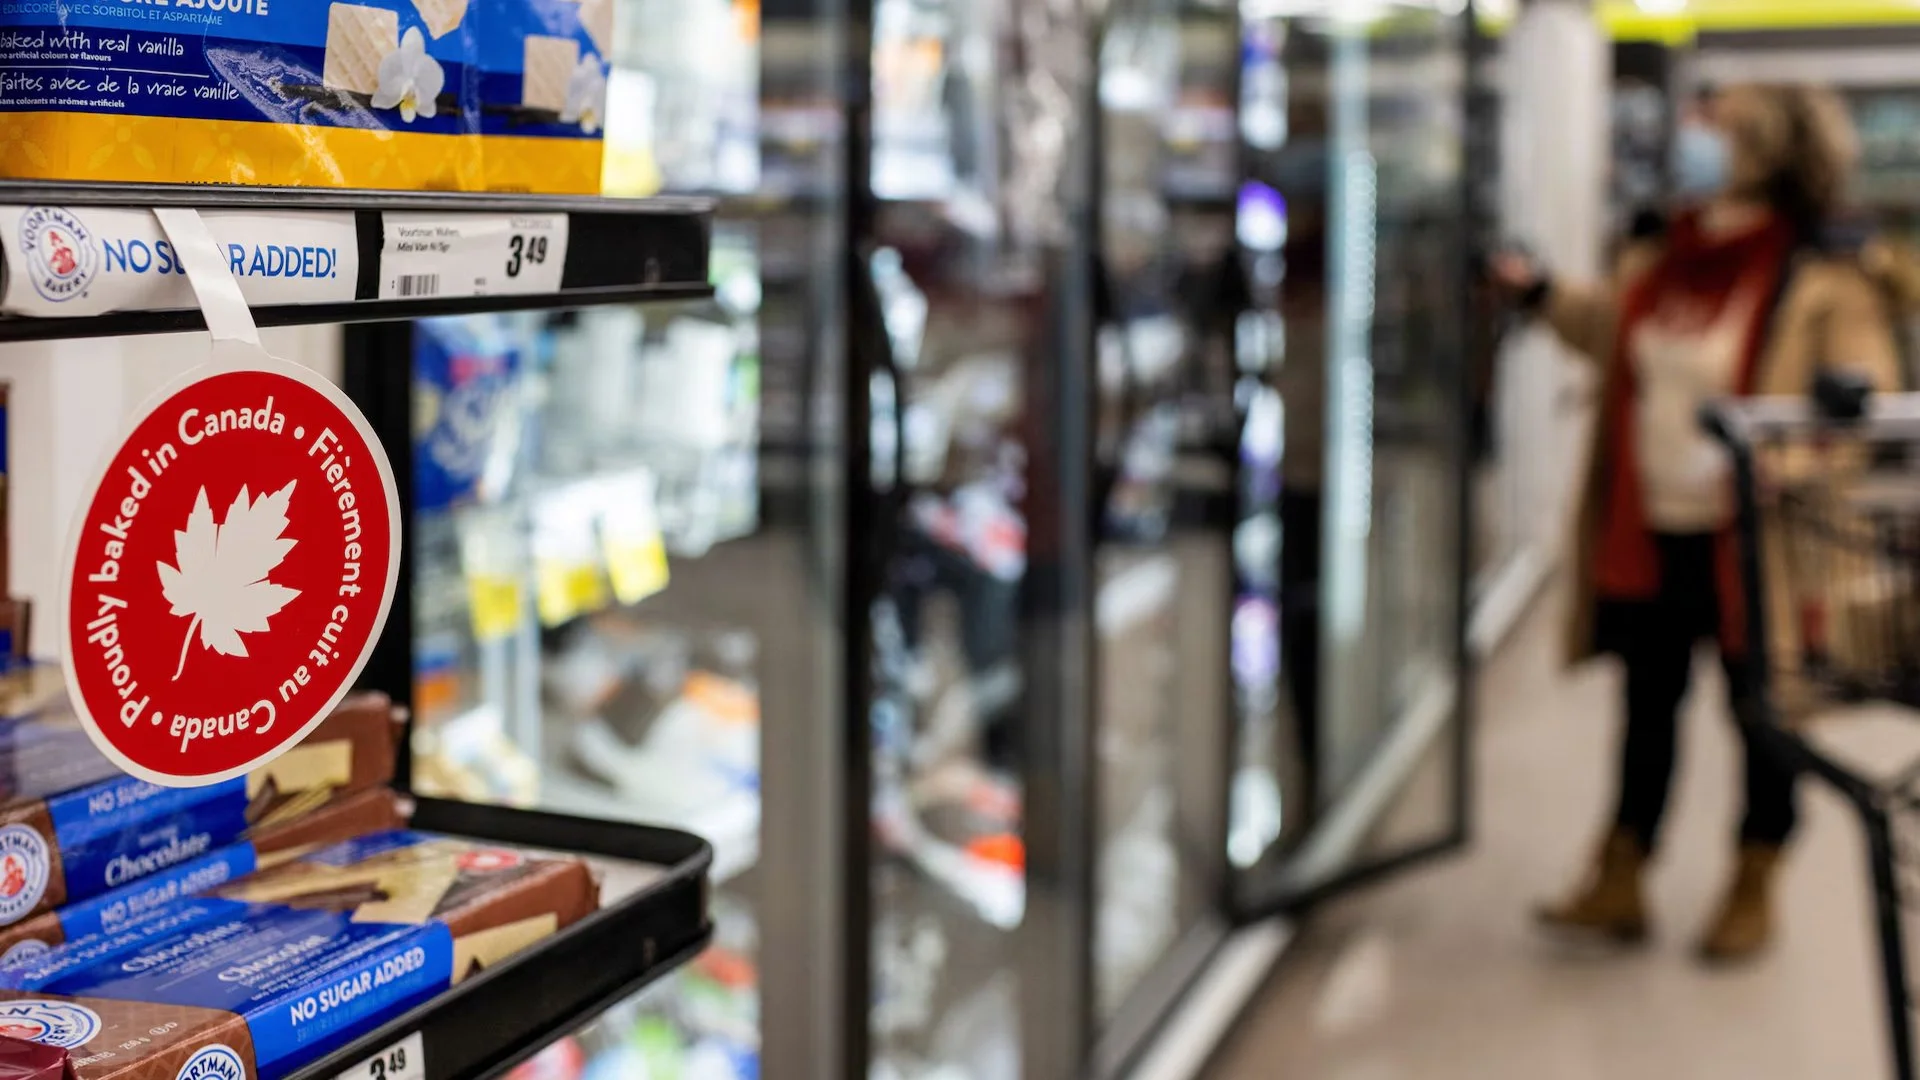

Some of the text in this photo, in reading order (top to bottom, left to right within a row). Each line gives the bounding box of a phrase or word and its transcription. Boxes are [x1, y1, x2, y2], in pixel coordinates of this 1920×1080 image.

[58, 4, 91, 15] AVEC
[93, 5, 147, 19] SORBITOL
[149, 10, 161, 20] ET
[162, 11, 223, 26] ASPARTAME
[0, 31, 184, 56] baked with real vanilla
[8, 50, 39, 59] artificial
[41, 51, 68, 59] colours
[80, 52, 112, 62] flavours
[0, 72, 239, 101] faites avec de la vraie vanille
[16, 97, 48, 105] colorants
[49, 97, 57, 105] ni
[58, 98, 88, 106] arômes
[89, 99, 125, 108] artificiels
[102, 239, 152, 274] NO
[247, 244, 336, 279] ADDED!
[178, 396, 286, 446] Canada
[141, 442, 178, 477] in
[88, 465, 152, 582] baked
[169, 426, 362, 754] Fièrement cuit au Canada
[87, 594, 150, 728] Proudly
[290, 997, 317, 1026] NO
[319, 971, 372, 1012] SUGAR
[373, 946, 425, 988] ADDED
